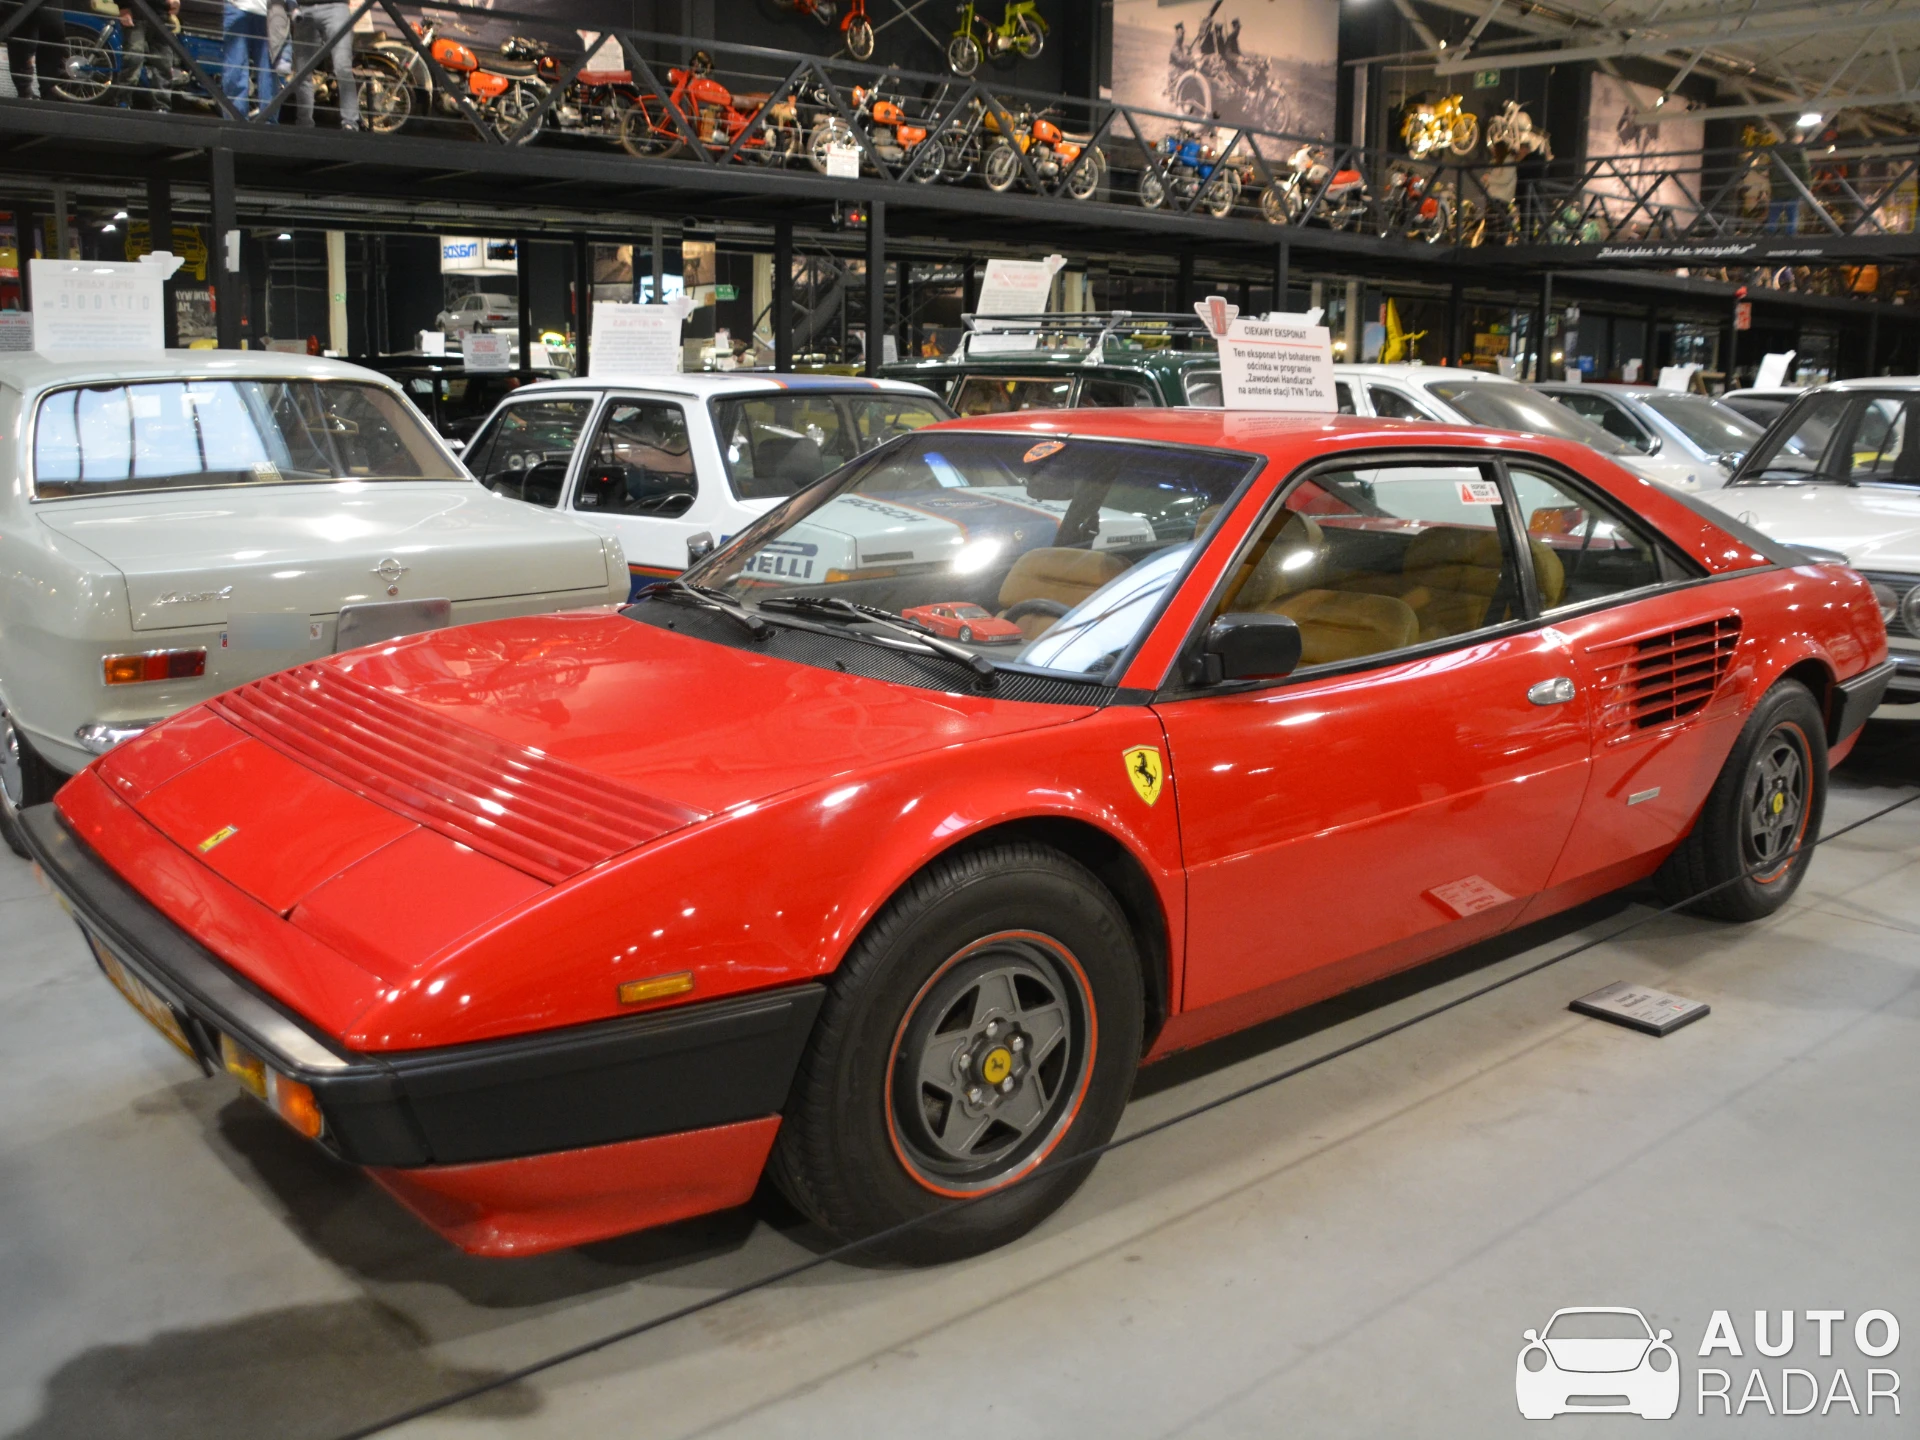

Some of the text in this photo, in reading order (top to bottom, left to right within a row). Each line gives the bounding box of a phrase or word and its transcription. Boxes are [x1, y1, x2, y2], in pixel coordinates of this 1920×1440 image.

[1244, 326, 1306, 339] CIEKAWY EKSPONAT
[1233, 348, 1321, 361] Ten eksponat był bohaterem
[1247, 362, 1272, 371] odcinka
[1280, 365, 1312, 374] programie
[1248, 387, 1272, 396] antenie
[1273, 387, 1290, 398] stacji
[1291, 388, 1304, 396] TVN
[1305, 388, 1324, 397] Turbo.
[838, 498, 928, 522] BOSCH
[744, 554, 814, 579] RELLI
